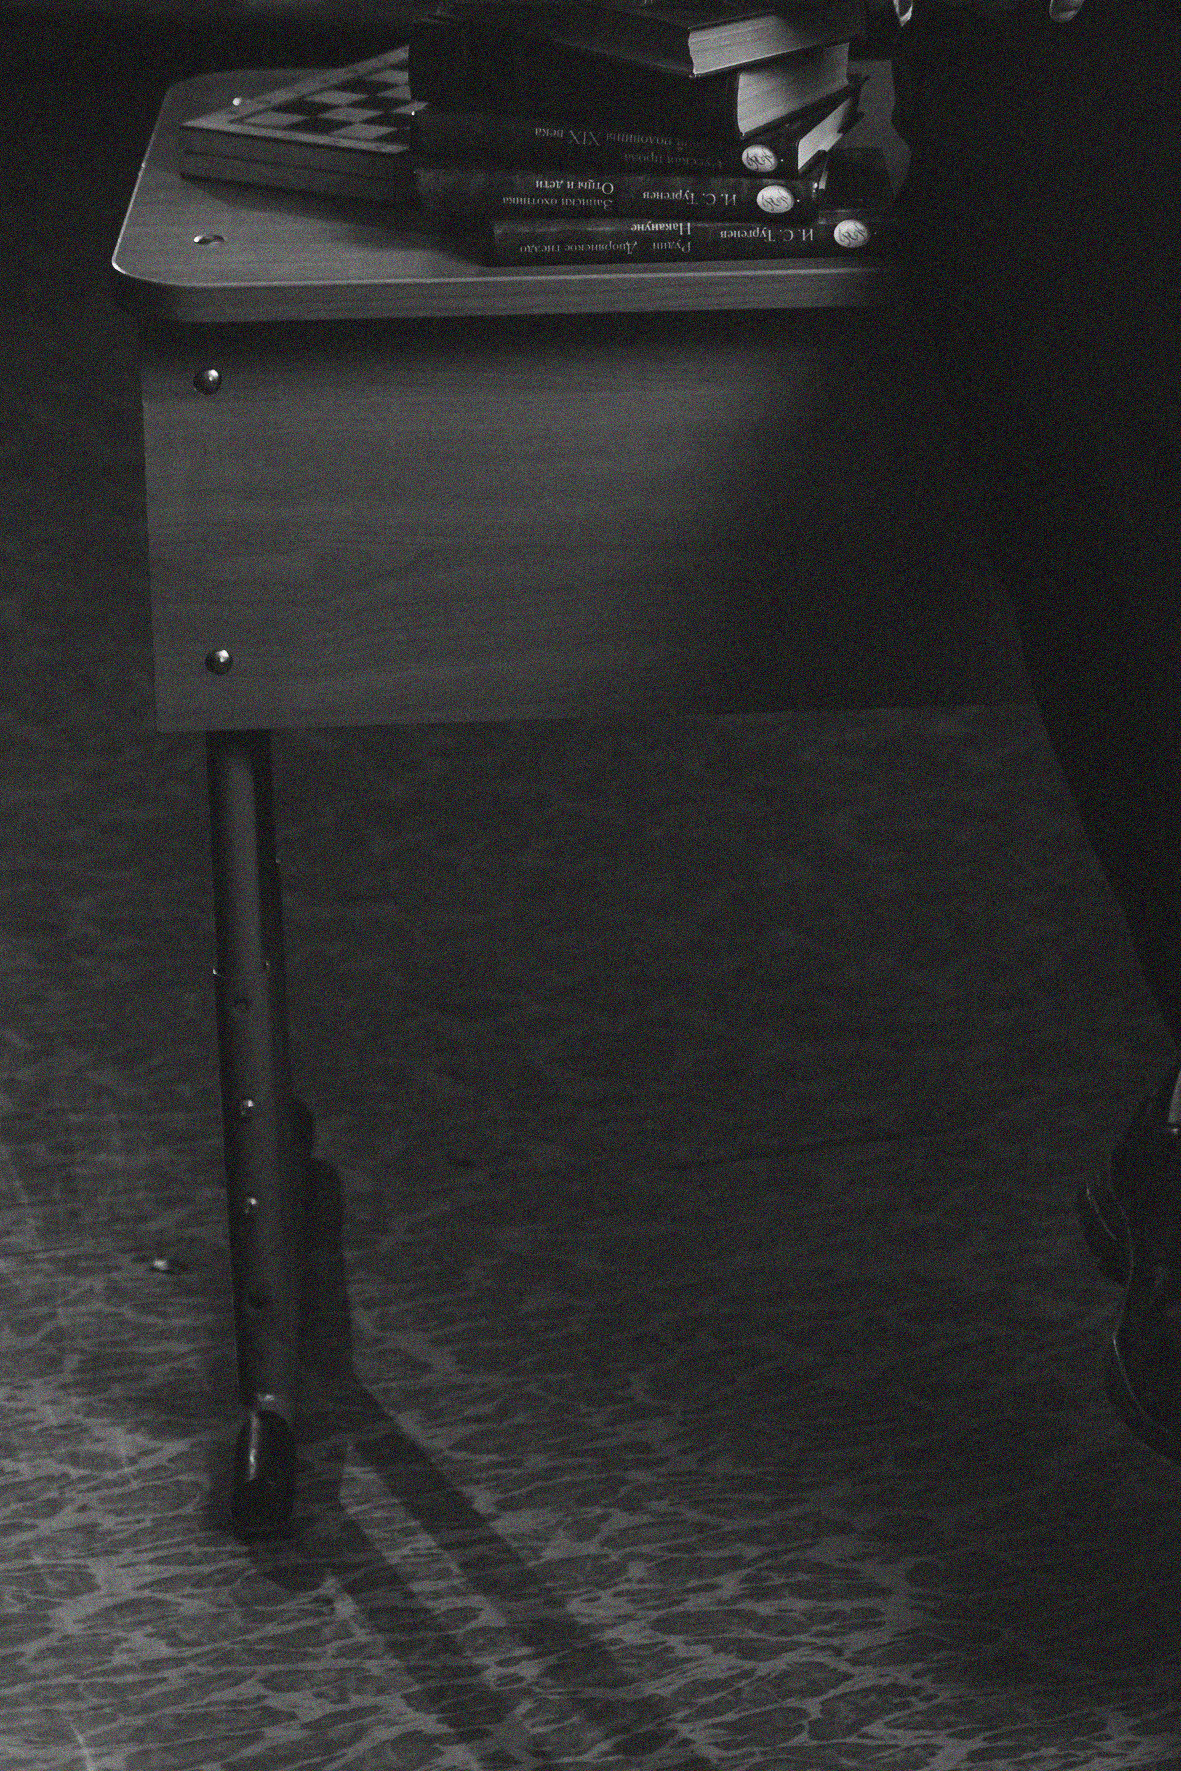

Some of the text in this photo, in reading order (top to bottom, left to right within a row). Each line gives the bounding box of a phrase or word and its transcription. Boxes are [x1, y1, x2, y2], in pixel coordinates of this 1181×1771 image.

[534, 127, 564, 138] века
[568, 129, 600, 146] XIX
[535, 179, 614, 195] Отцы и дети
[502, 196, 613, 210] Записки охотника
[643, 189, 737, 206] И. С. Тургенев
[630, 221, 692, 236] Накануне
[720, 226, 814, 243] И. С. Тургенев
[519, 240, 692, 255] Рудин Дворянское гнездо
